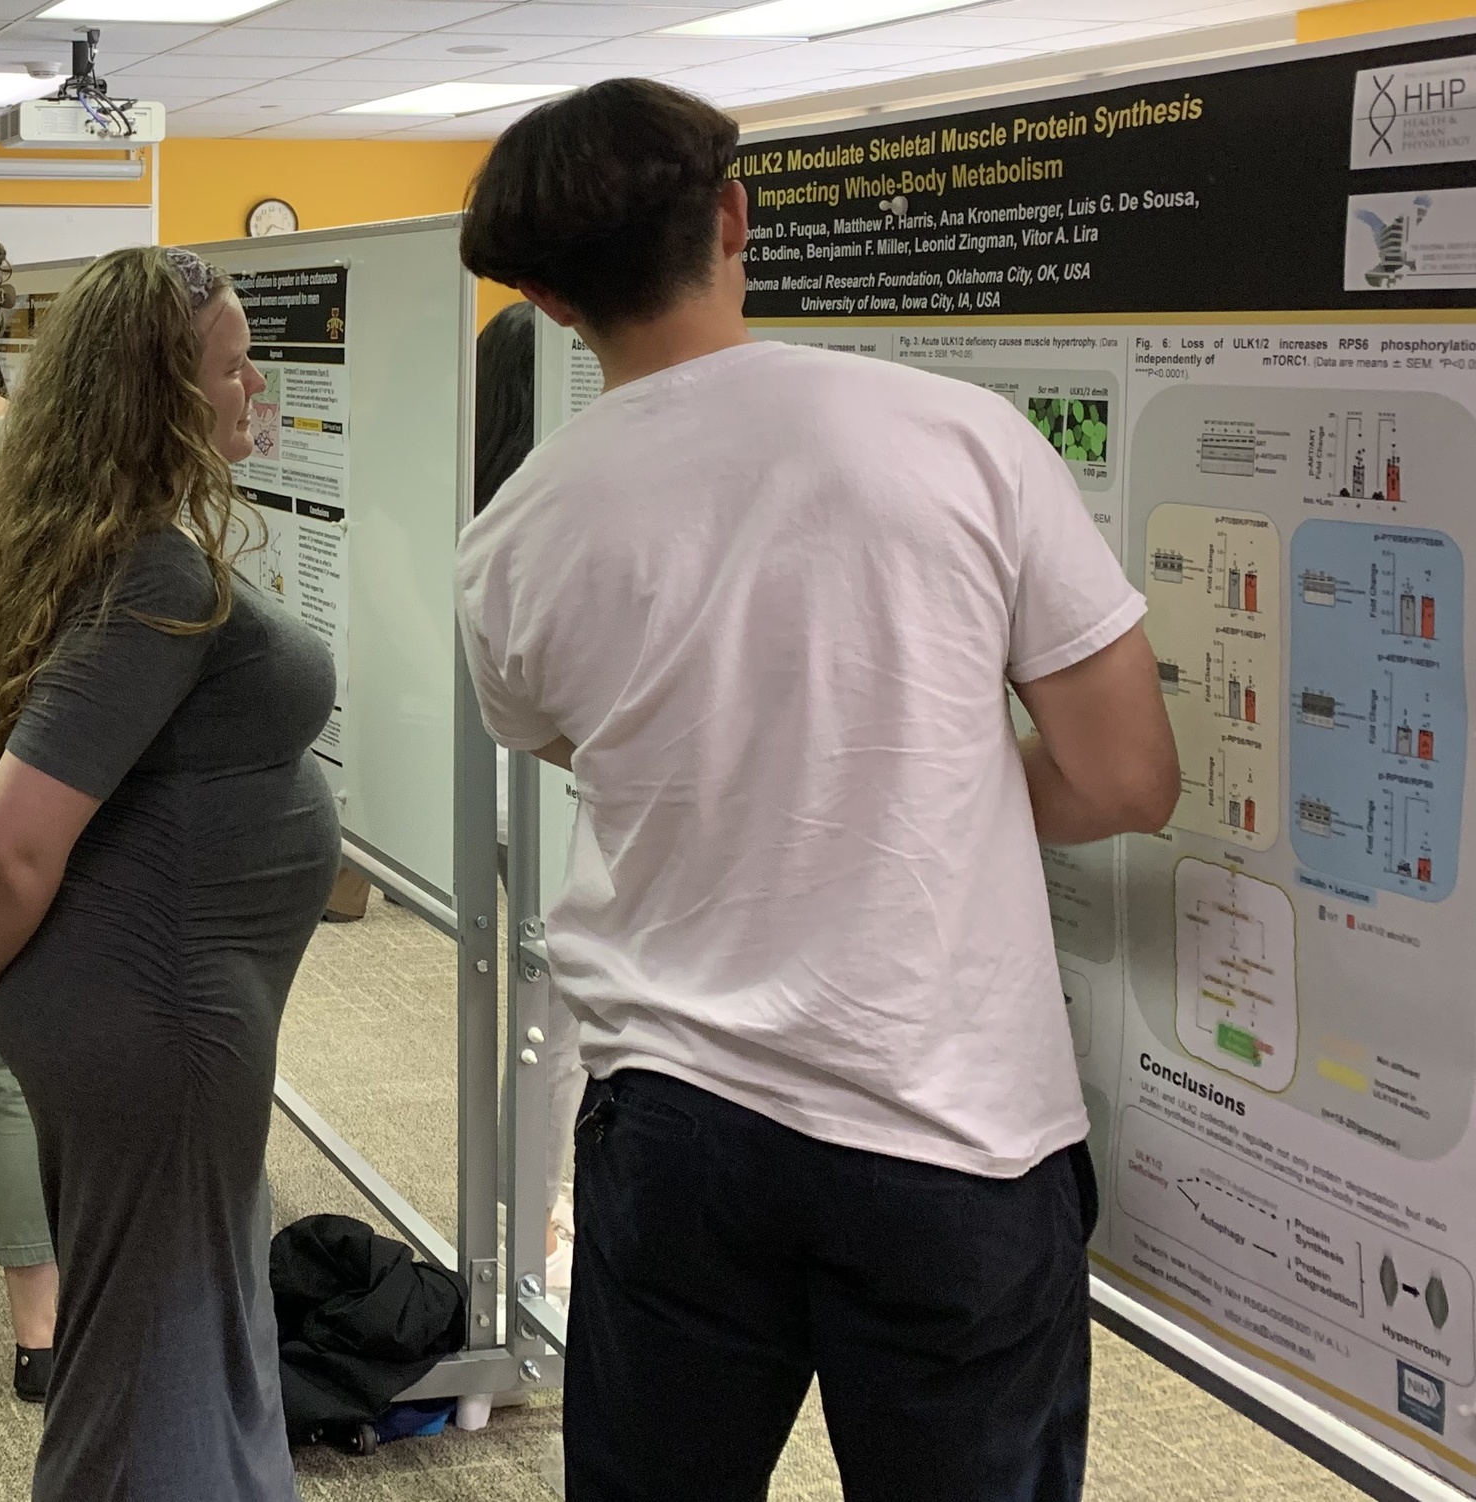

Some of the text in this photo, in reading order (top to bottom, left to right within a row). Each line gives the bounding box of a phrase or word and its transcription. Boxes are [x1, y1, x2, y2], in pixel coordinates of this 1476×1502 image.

[1405, 78, 1466, 112] HHP
[744, 152, 782, 177] ULK2
[787, 143, 865, 172] Modulate
[869, 131, 936, 162] Skeletal
[941, 122, 1007, 153] Muscle
[1013, 111, 1087, 144] Protein
[1094, 93, 1203, 138] Synthesis
[758, 156, 1063, 210] Impacting Whole-Body Metabolism
[746, 189, 1200, 241] ordan D. Fuqua, Matthew P. Harris, Ana Kronemberger, Luis G. De Sousa,
[750, 224, 1099, 262] C. Bodine, Benjamin F. Miller, Leonid Zingman, Vitor A. Lira
[745, 262, 1091, 292] lahoma Medical Research Foundation, Oklahoma City, OK, USA
[801, 291, 1001, 314] University of Iowa, Iowa City, IA, USA
[999, 338, 1022, 347] causes
[1024, 337, 1050, 347] muscle
[1053, 337, 1097, 349] hypertrophy.
[1136, 338, 1153, 350] Fig.
[1181, 338, 1204, 349] Loss
[1214, 338, 1224, 349] of
[1233, 338, 1269, 349] ULK1/2
[1279, 338, 1328, 350] increases
[1339, 339, 1369, 350] RPS6
[1135, 354, 1202, 367] independently
[1205, 354, 1215, 365] of
[1263, 355, 1310, 366] mTORC1.
[1356, 358, 1388, 368] means
[1140, 1052, 1246, 1117] Conclusions
[1200, 1212, 1246, 1245] Autophagy
[1294, 1218, 1331, 1244] Protein
[1405, 1205, 1421, 1222] but
[1425, 1216, 1448, 1232] also
[1295, 1233, 1345, 1265] Synthesis
[1294, 1256, 1332, 1282] Protein
[1295, 1271, 1359, 1310] Degradation
[1382, 1323, 1452, 1367] Hypertrophy
